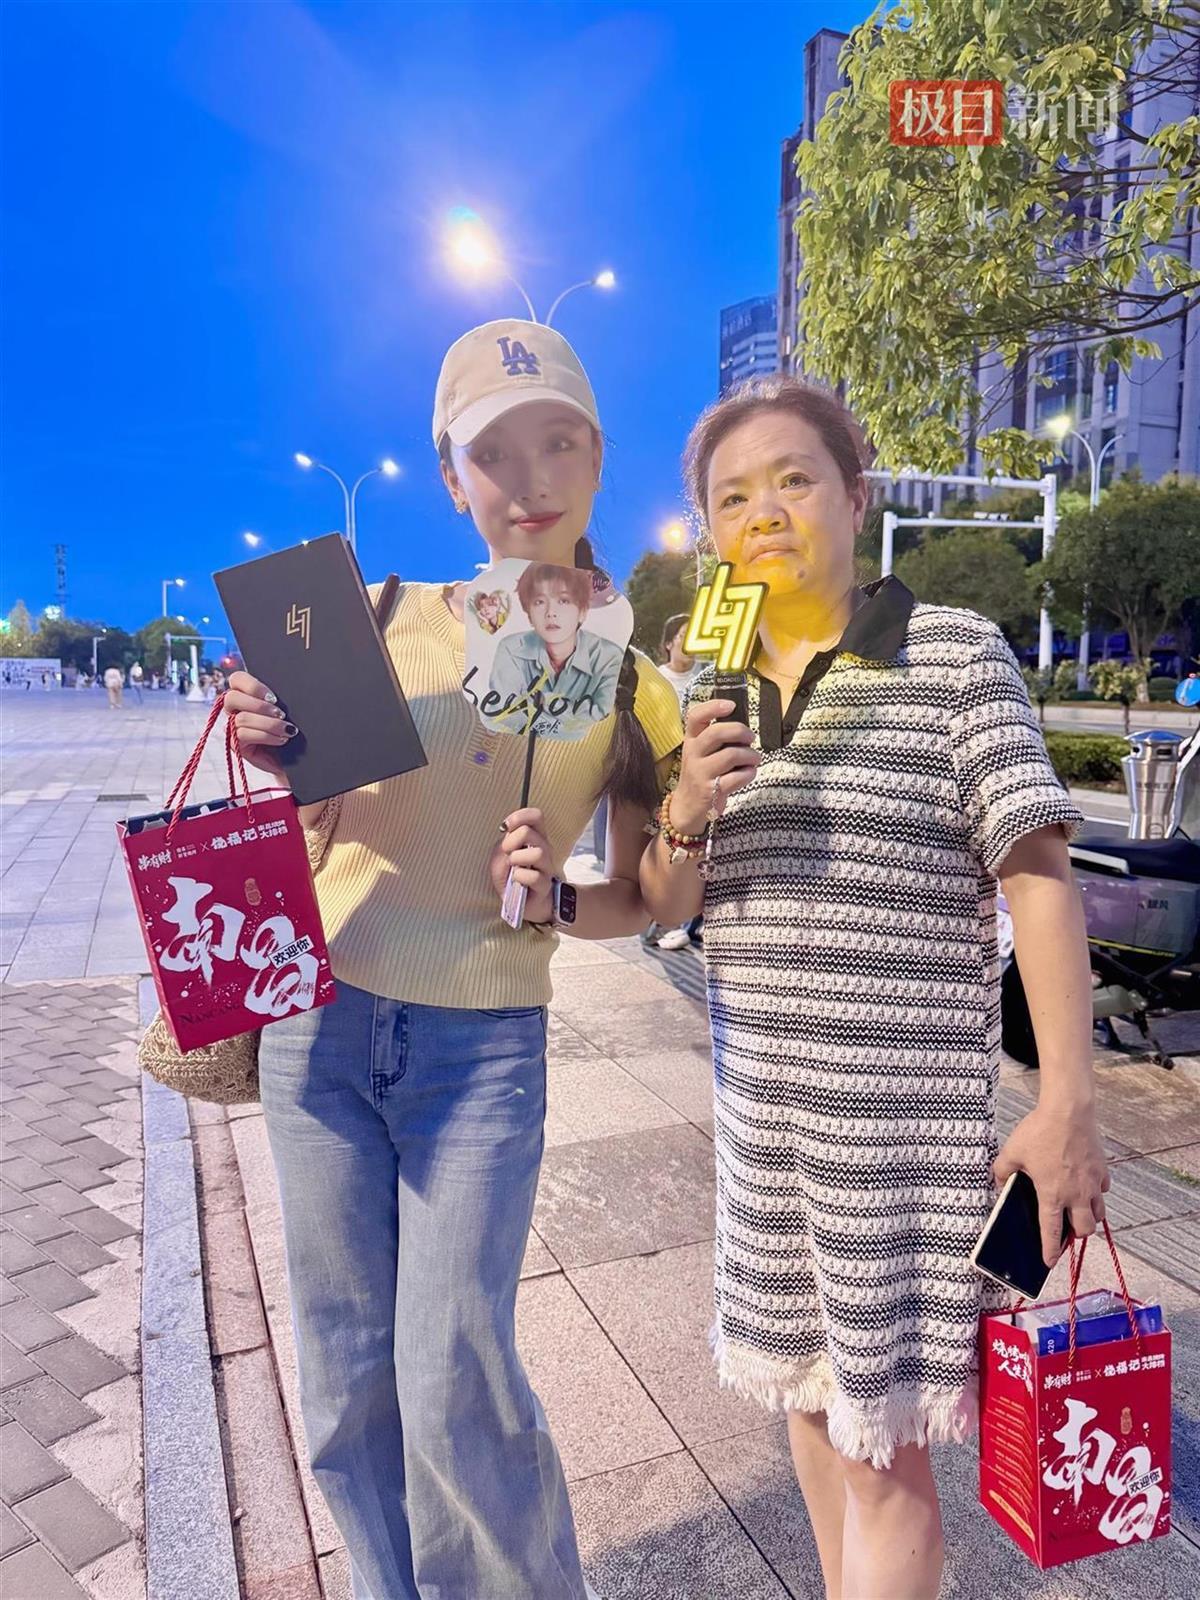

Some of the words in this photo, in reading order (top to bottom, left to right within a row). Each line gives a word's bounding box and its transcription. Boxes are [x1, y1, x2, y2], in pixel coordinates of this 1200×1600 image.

[497, 336, 541, 376] LA
[273, 939, 311, 966] 欢迎你
[1129, 1470, 1160, 1494] 欢迎你
